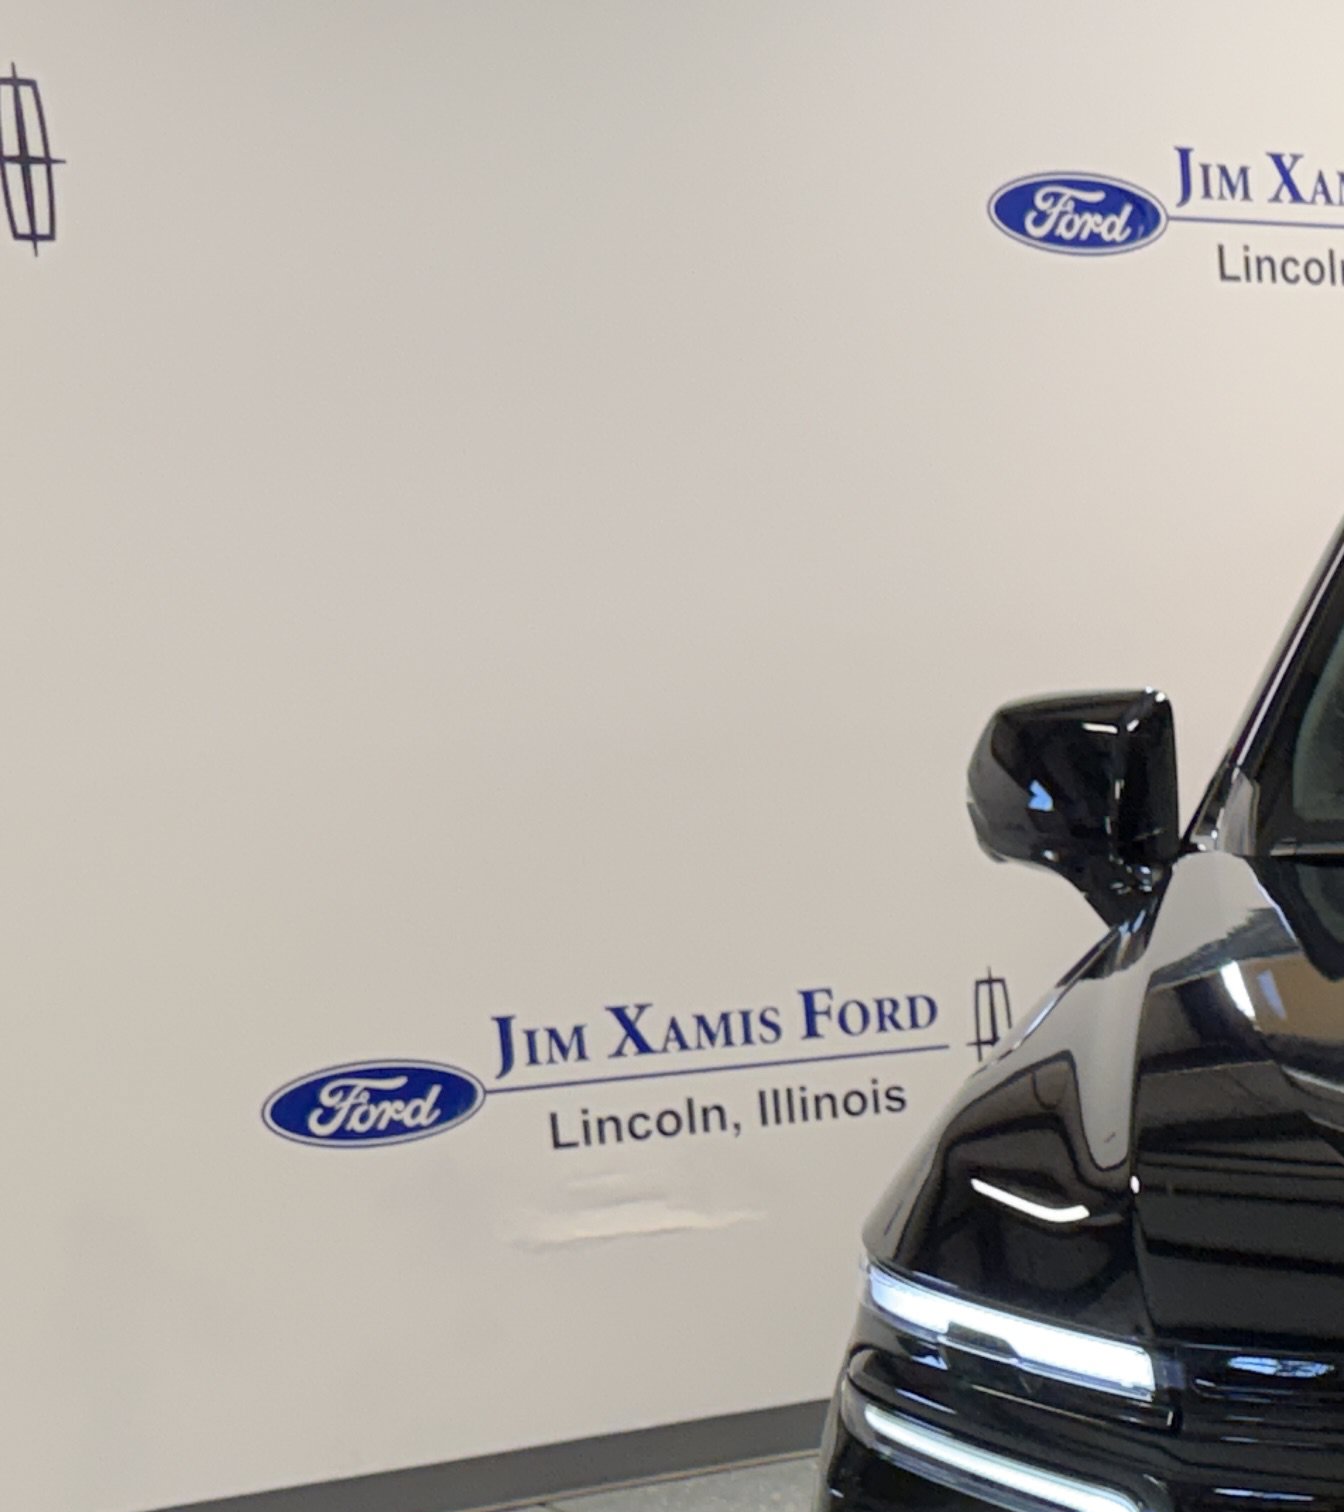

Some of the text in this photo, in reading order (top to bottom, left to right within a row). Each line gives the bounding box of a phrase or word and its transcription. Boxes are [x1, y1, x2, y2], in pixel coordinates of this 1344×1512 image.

[1174, 146, 1251, 208] JIM
[1024, 184, 1132, 243] Ford
[491, 988, 937, 1078] JIM XAMIS FORD
[307, 1077, 442, 1135] Ford
[550, 1078, 908, 1150] Lincoln, Illinois
